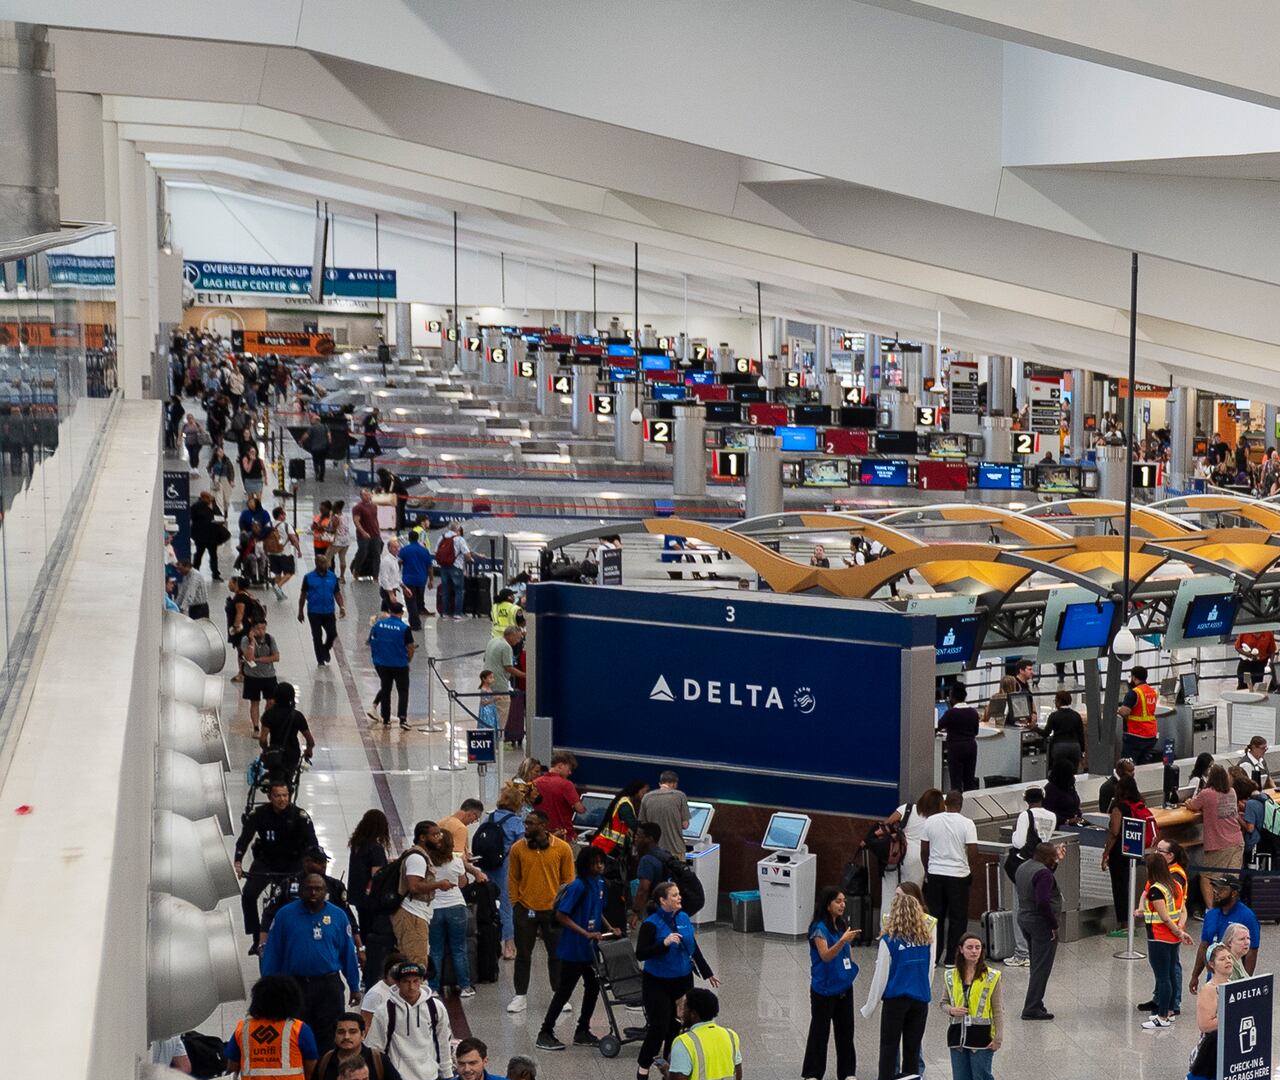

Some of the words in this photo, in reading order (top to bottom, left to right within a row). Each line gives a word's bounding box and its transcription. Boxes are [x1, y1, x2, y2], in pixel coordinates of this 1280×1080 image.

[203, 264, 248, 277] OVERSIZE
[249, 265, 270, 277] BAG
[271, 267, 309, 278] PICK-UP
[357, 272, 385, 282] DELTA
[202, 278, 223, 289] BAG
[225, 279, 248, 290] HELP
[250, 280, 286, 293] CENTER
[197, 293, 233, 305] ELTA
[470, 339, 479, 350] 7
[493, 350, 503, 362] 6
[696, 348, 706, 359] 7
[522, 363, 533, 376] 5
[737, 359, 747, 372] 6
[555, 377, 568, 392] 4
[787, 373, 798, 387] 5
[847, 389, 859, 403] 4
[598, 396, 611, 413] 3
[750, 414, 758, 425] 3
[920, 408, 933, 425] 3
[655, 423, 669, 442] 2
[827, 442, 834, 453] 2
[1016, 435, 1031, 453] 2
[729, 453, 737, 475] 1
[921, 476, 928, 488] 1
[1140, 466, 1149, 487] 1
[726, 606, 736, 623] 3
[683, 678, 785, 711] DELTA
[470, 740, 491, 749] EXIT
[1237, 988, 1262, 1001] DELTA
[253, 1045, 277, 1056] unifi
[1230, 1059, 1257, 1074] CHECK-IN
[1257, 1057, 1264, 1067] &
[1254, 1066, 1270, 1079] HERE
